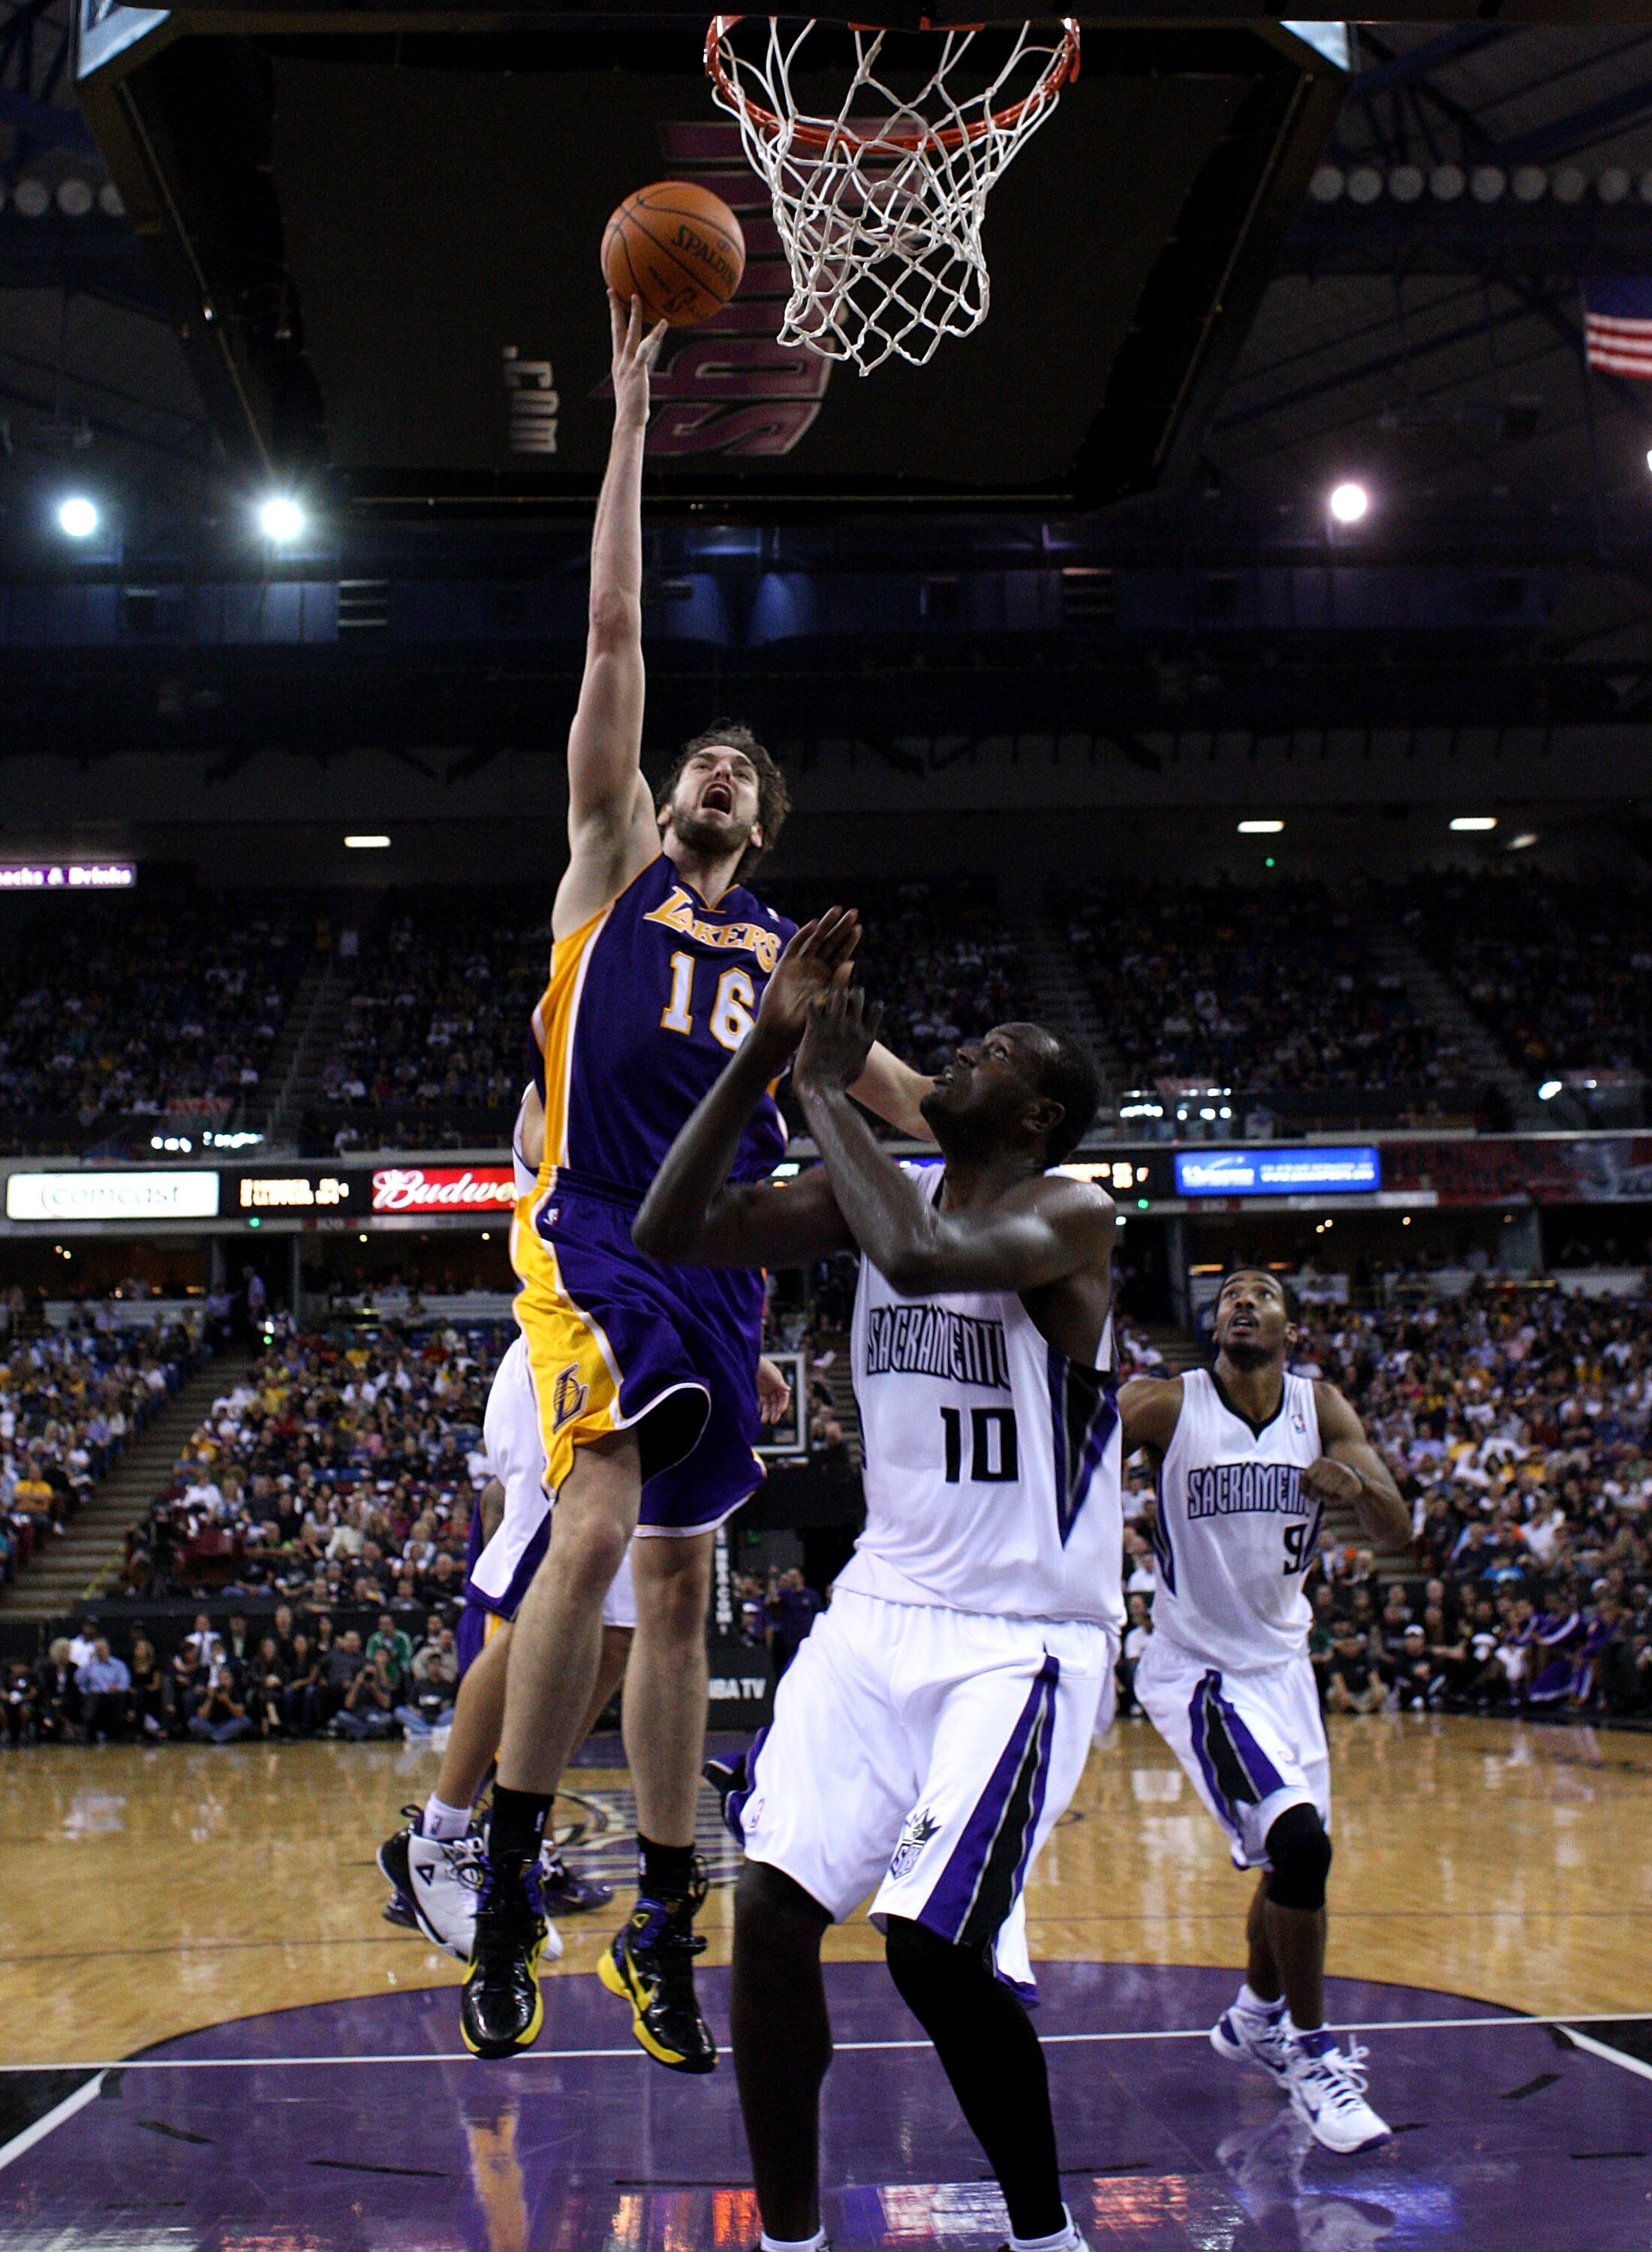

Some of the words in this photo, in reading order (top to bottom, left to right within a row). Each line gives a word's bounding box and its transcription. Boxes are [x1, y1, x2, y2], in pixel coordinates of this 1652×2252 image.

[671, 224, 739, 296] SPALDIN
[660, 950, 755, 1052] 16
[53, 1186, 179, 1204] comcast
[940, 1408, 1019, 1483] 10
[1187, 1462, 1310, 1519] SACRAMEN
[1284, 1524, 1307, 1575] 9
[739, 1678, 766, 1700] TV
